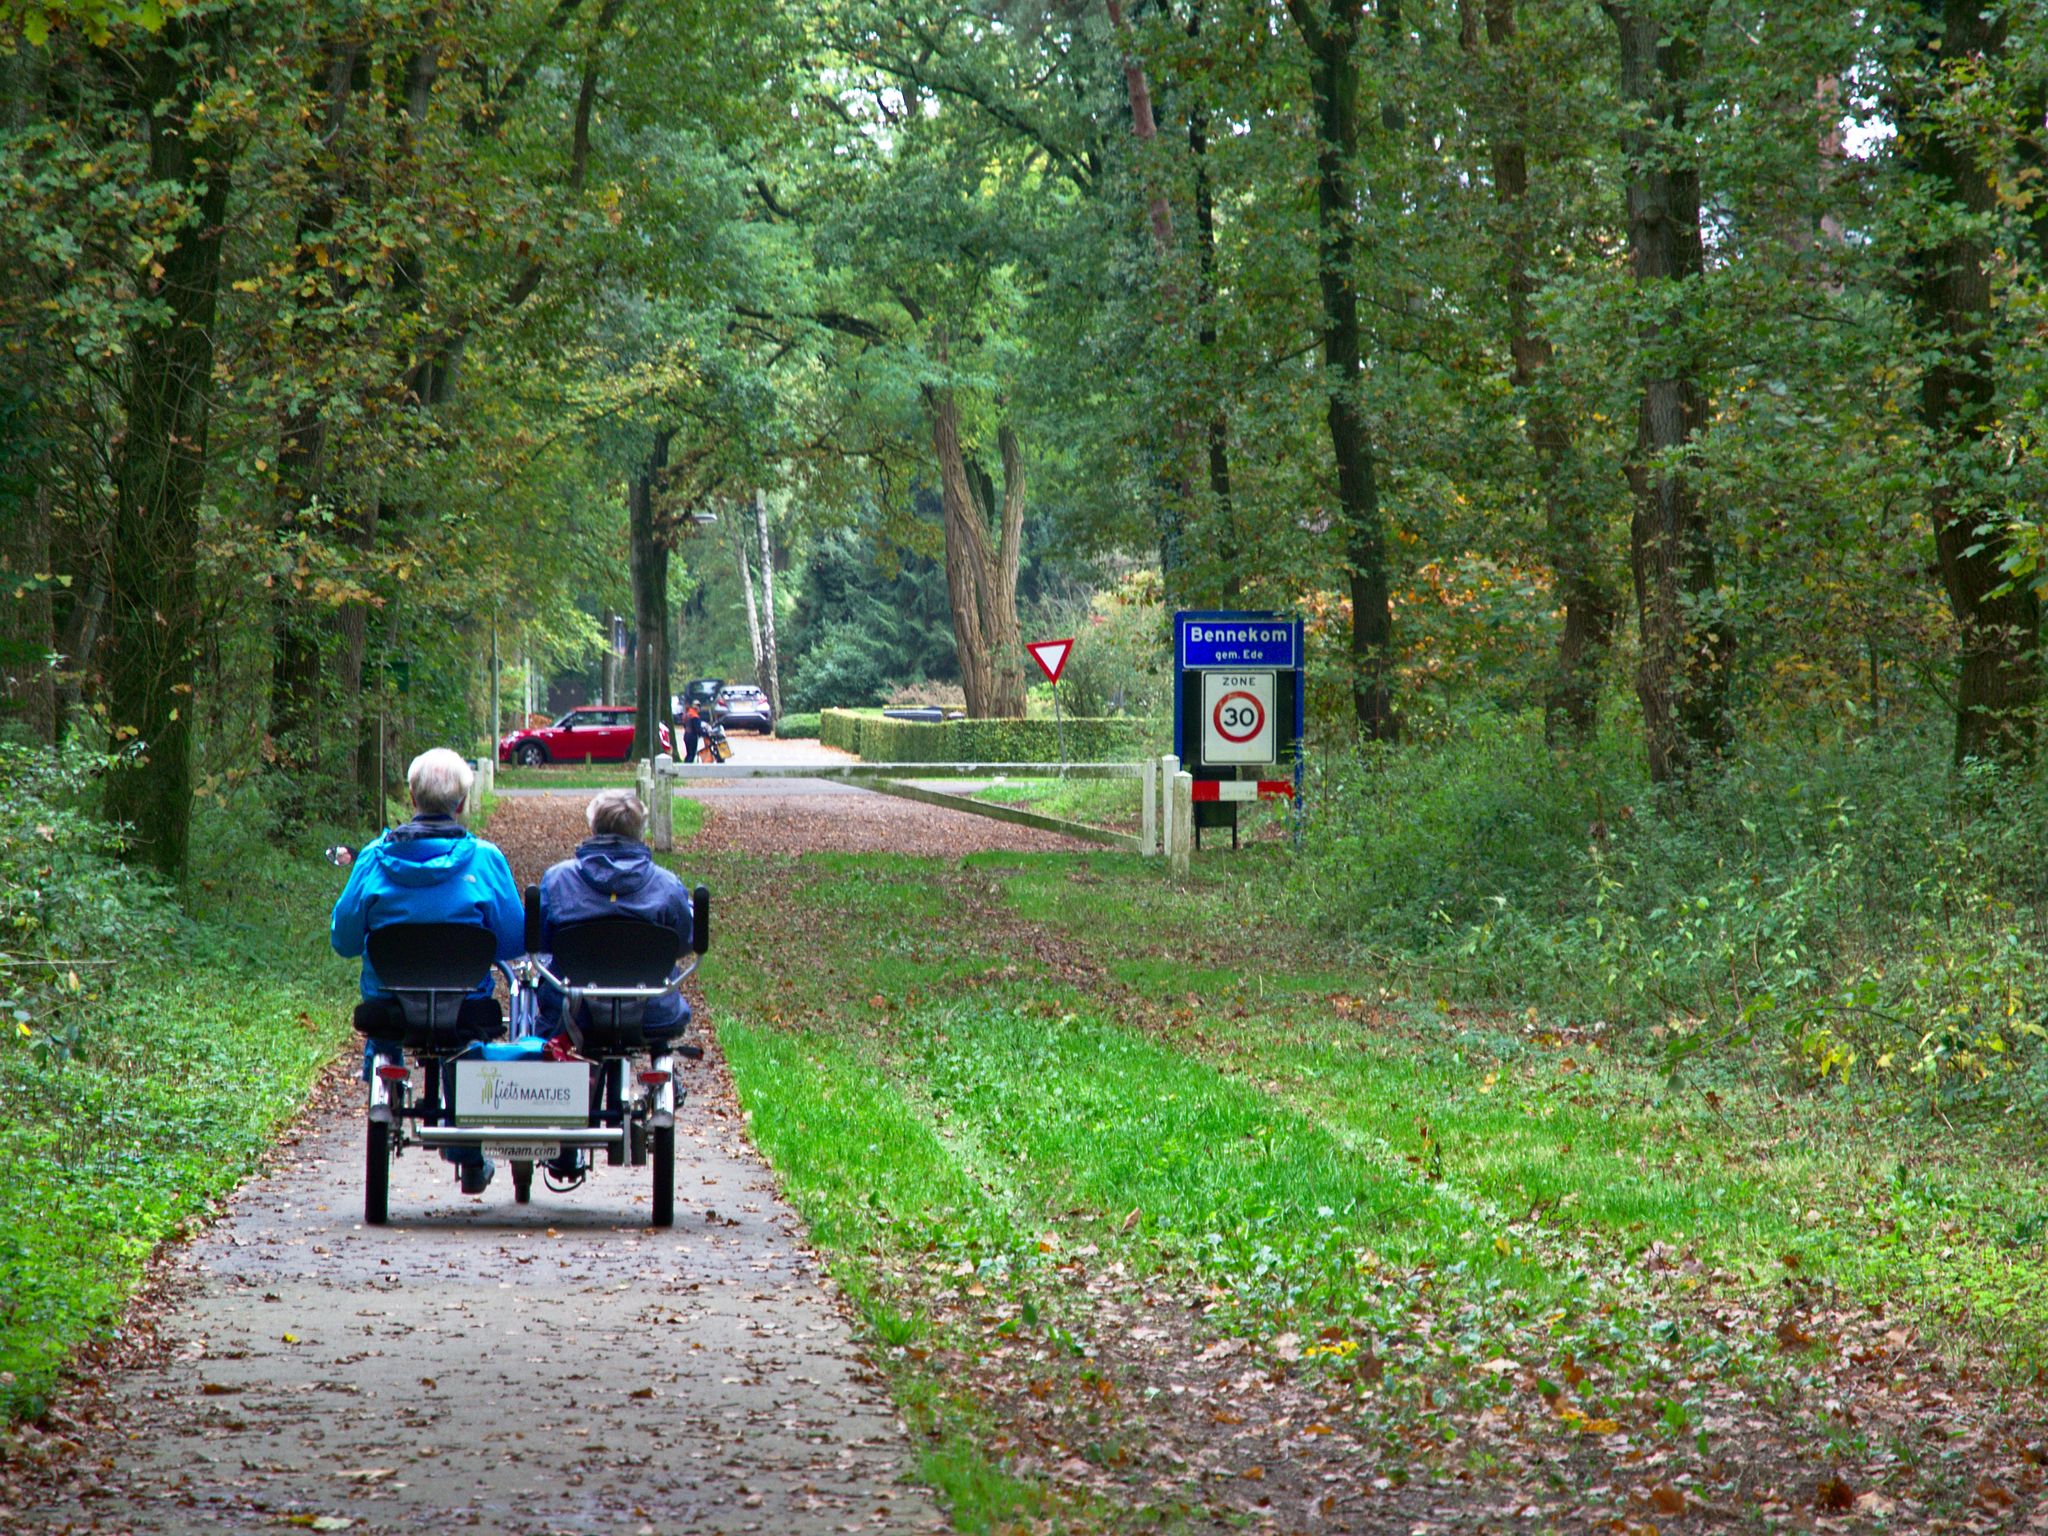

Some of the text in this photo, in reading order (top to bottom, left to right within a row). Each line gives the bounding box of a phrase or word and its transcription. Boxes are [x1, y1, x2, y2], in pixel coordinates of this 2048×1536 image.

[1191, 627, 1287, 642] Bennekom
[1215, 649, 1264, 661] gem. Ede
[1222, 677, 1256, 686] ZONE
[1223, 707, 1255, 727] 30
[520, 1088, 571, 1101] MAATJES
